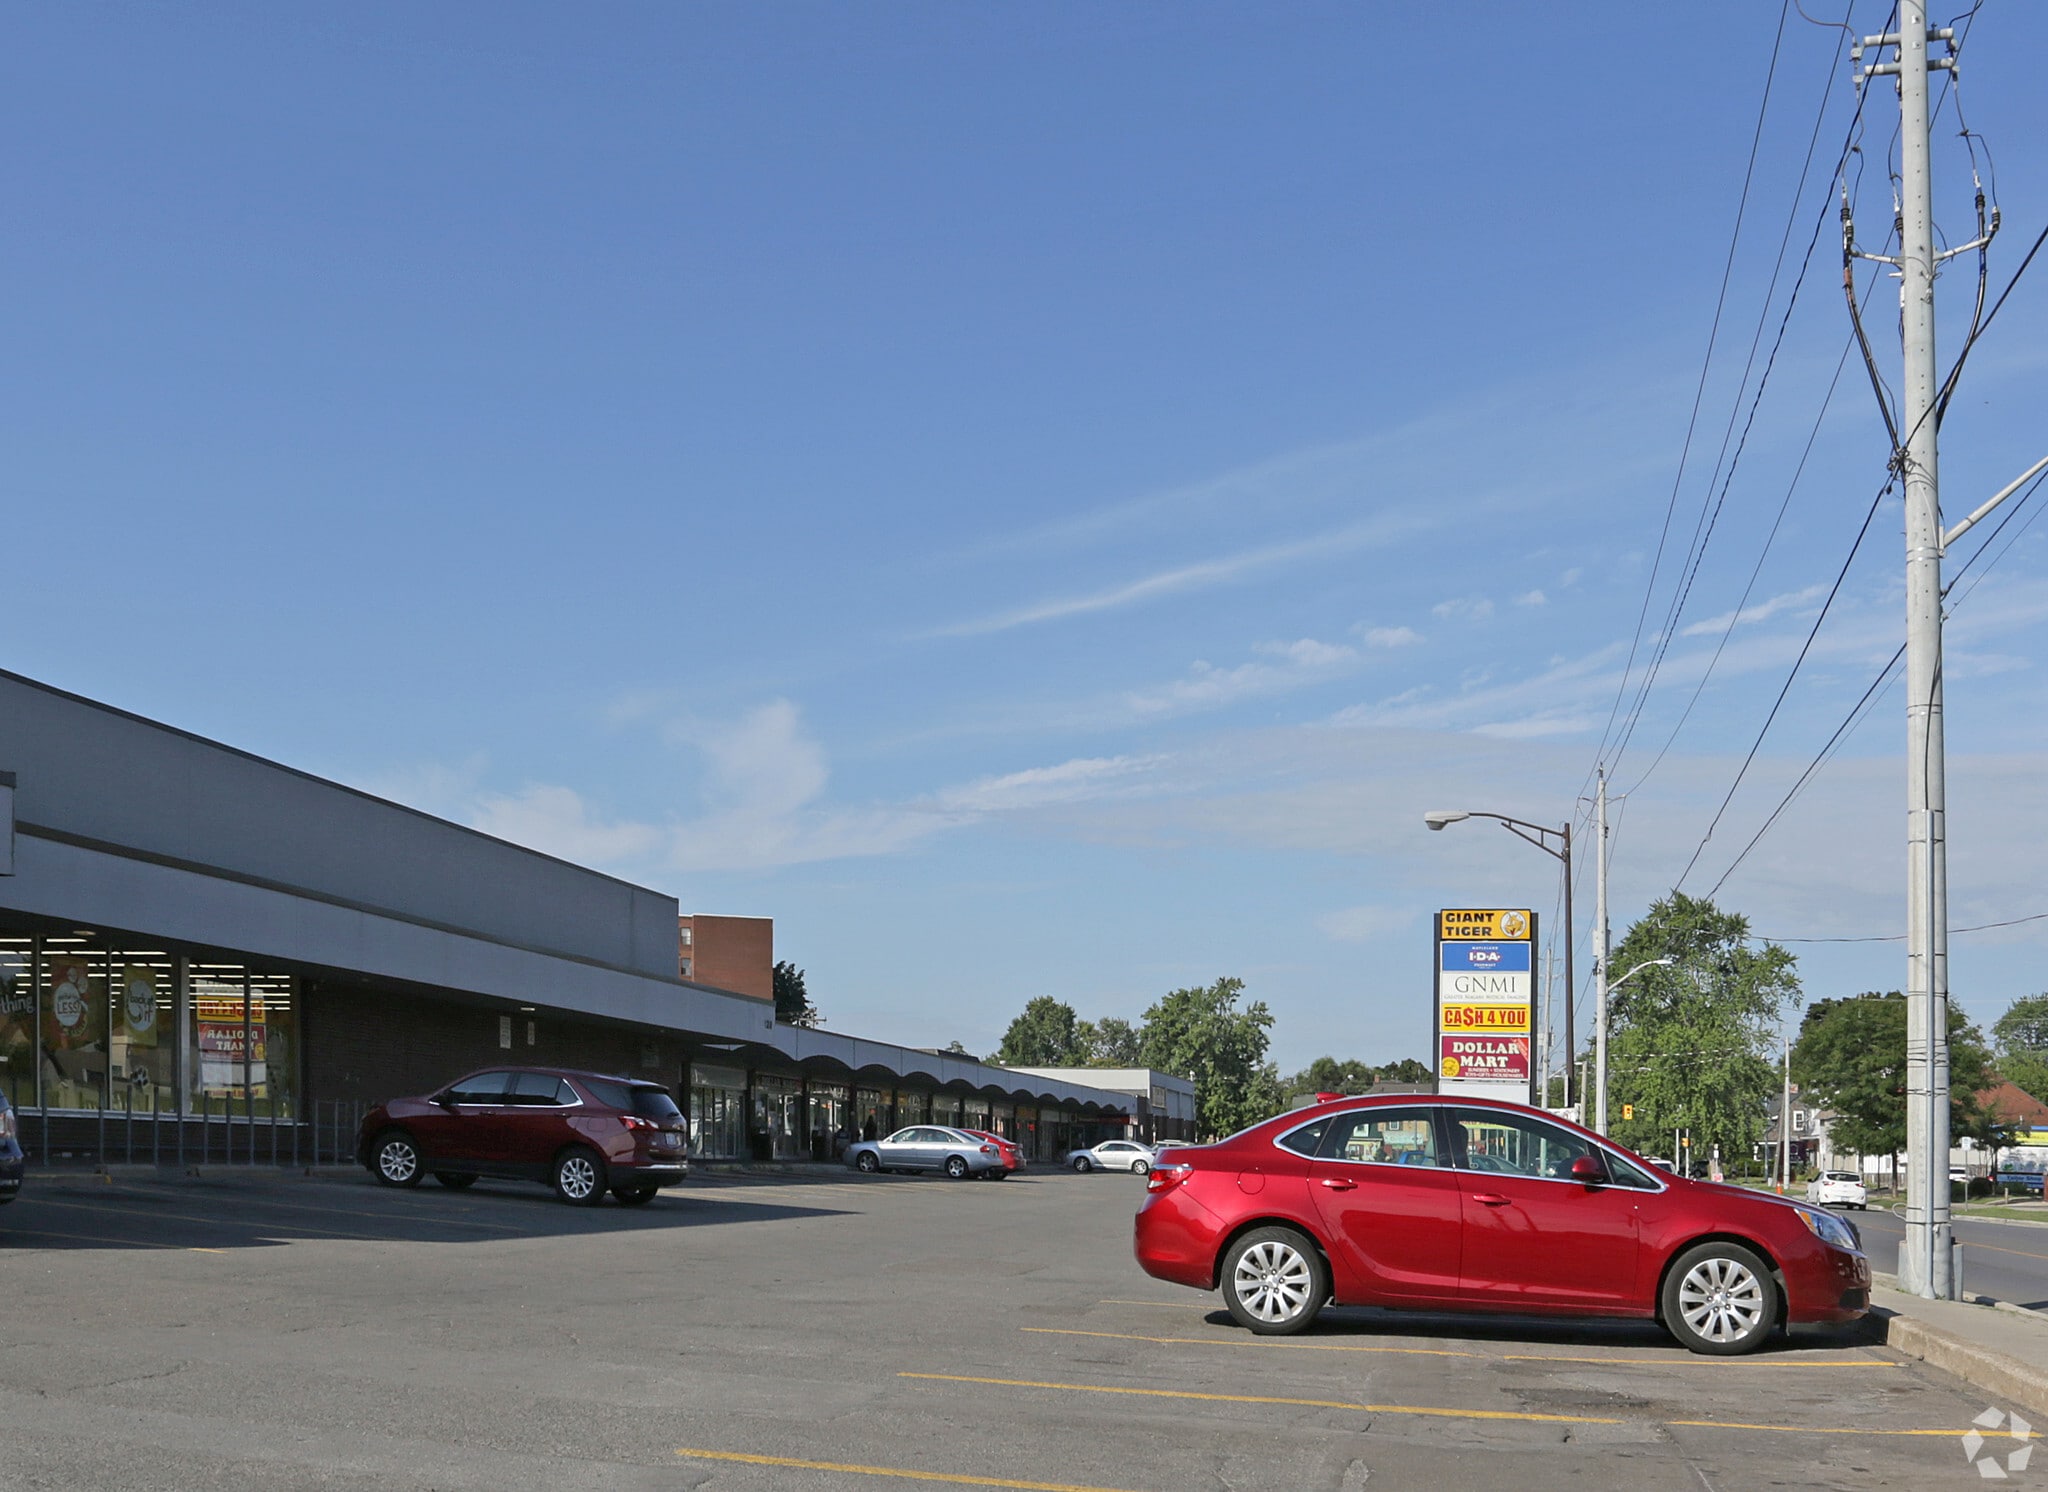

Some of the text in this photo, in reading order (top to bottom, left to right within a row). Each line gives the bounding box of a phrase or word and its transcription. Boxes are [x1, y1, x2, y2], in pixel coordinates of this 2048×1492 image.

[1445, 912, 1494, 922] GIANT
[1445, 926, 1492, 936] TIGER
[1454, 975, 1515, 993] GNMI
[1487, 1010, 1495, 1024] 4
[1499, 1010, 1526, 1025] YOU
[1452, 1041, 1520, 1054] DOLLAR
[1460, 1055, 1508, 1068] MART
